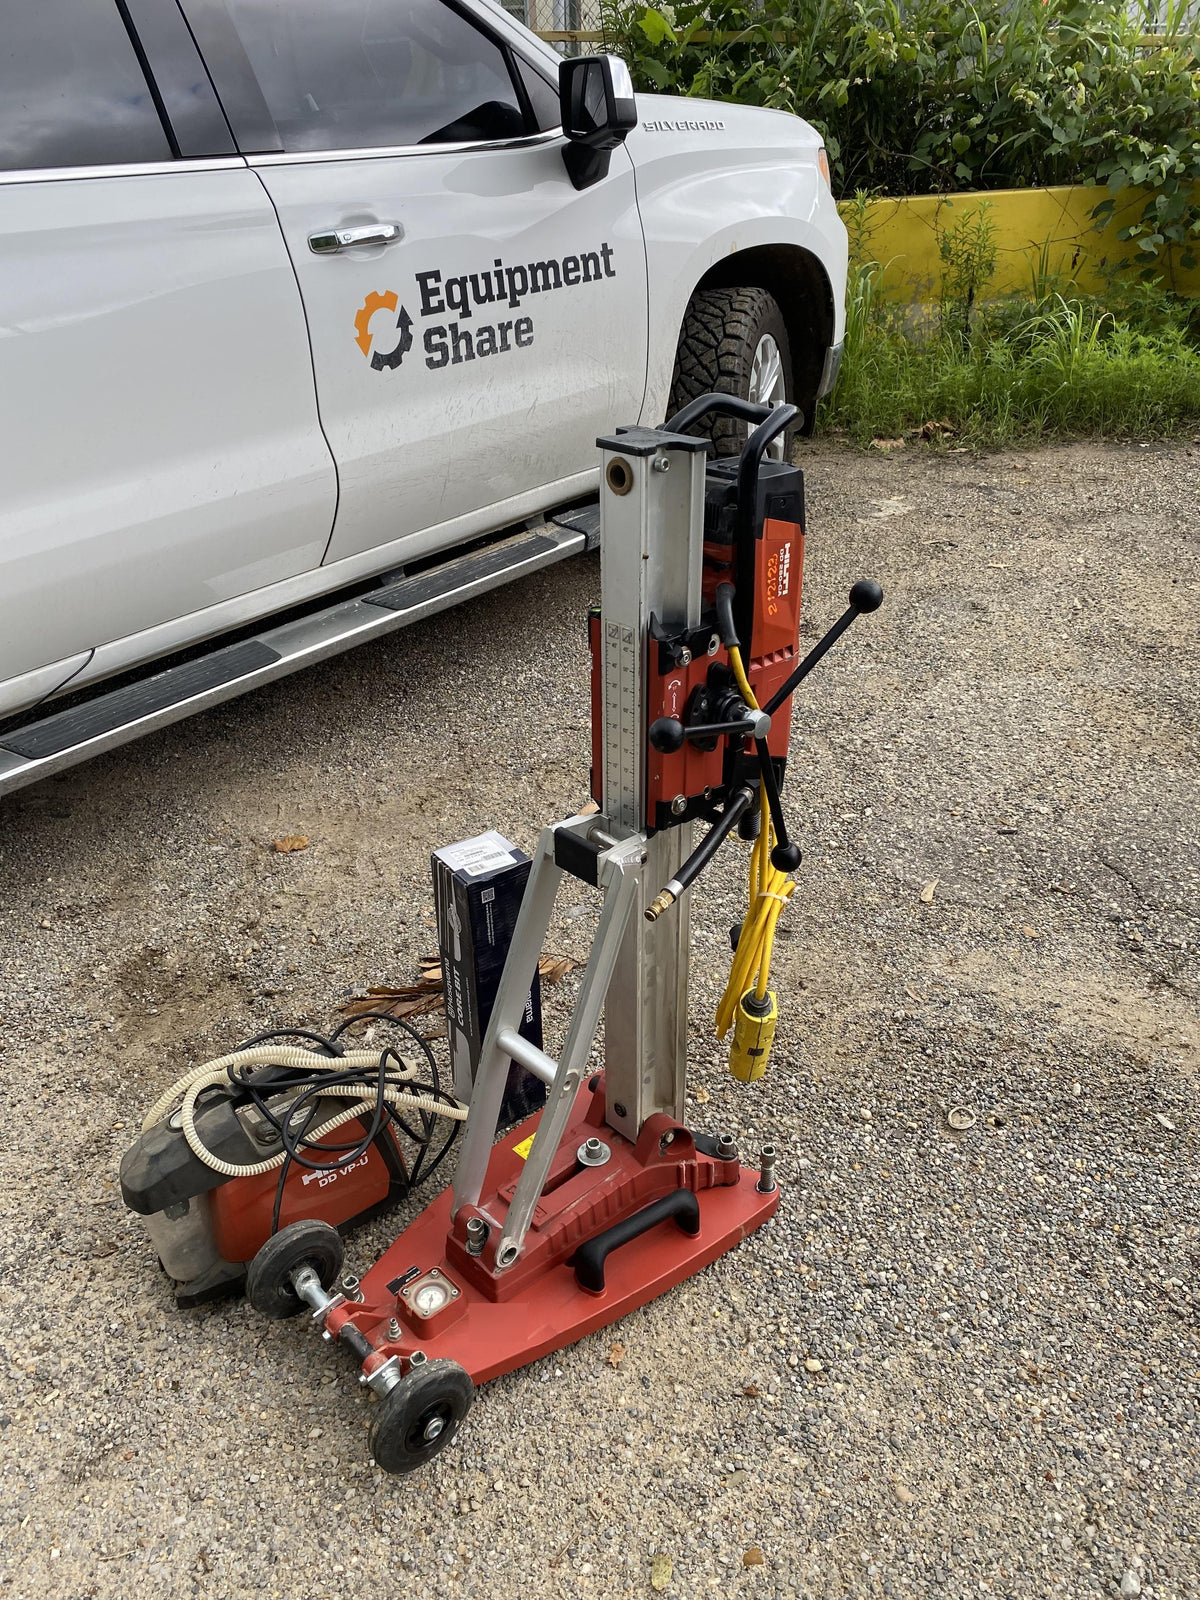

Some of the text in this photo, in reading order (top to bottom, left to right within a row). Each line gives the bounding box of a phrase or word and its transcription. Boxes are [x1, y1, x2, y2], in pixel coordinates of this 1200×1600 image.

[642, 120, 725, 132] SILVERADO
[415, 242, 616, 320] Equipment
[423, 316, 535, 370] Share
[783, 542, 791, 596] HILTI
[444, 957, 453, 1008] Husqvarna
[453, 966, 464, 1027] CORE BIT
[318, 1155, 369, 1188] DD VP-U
